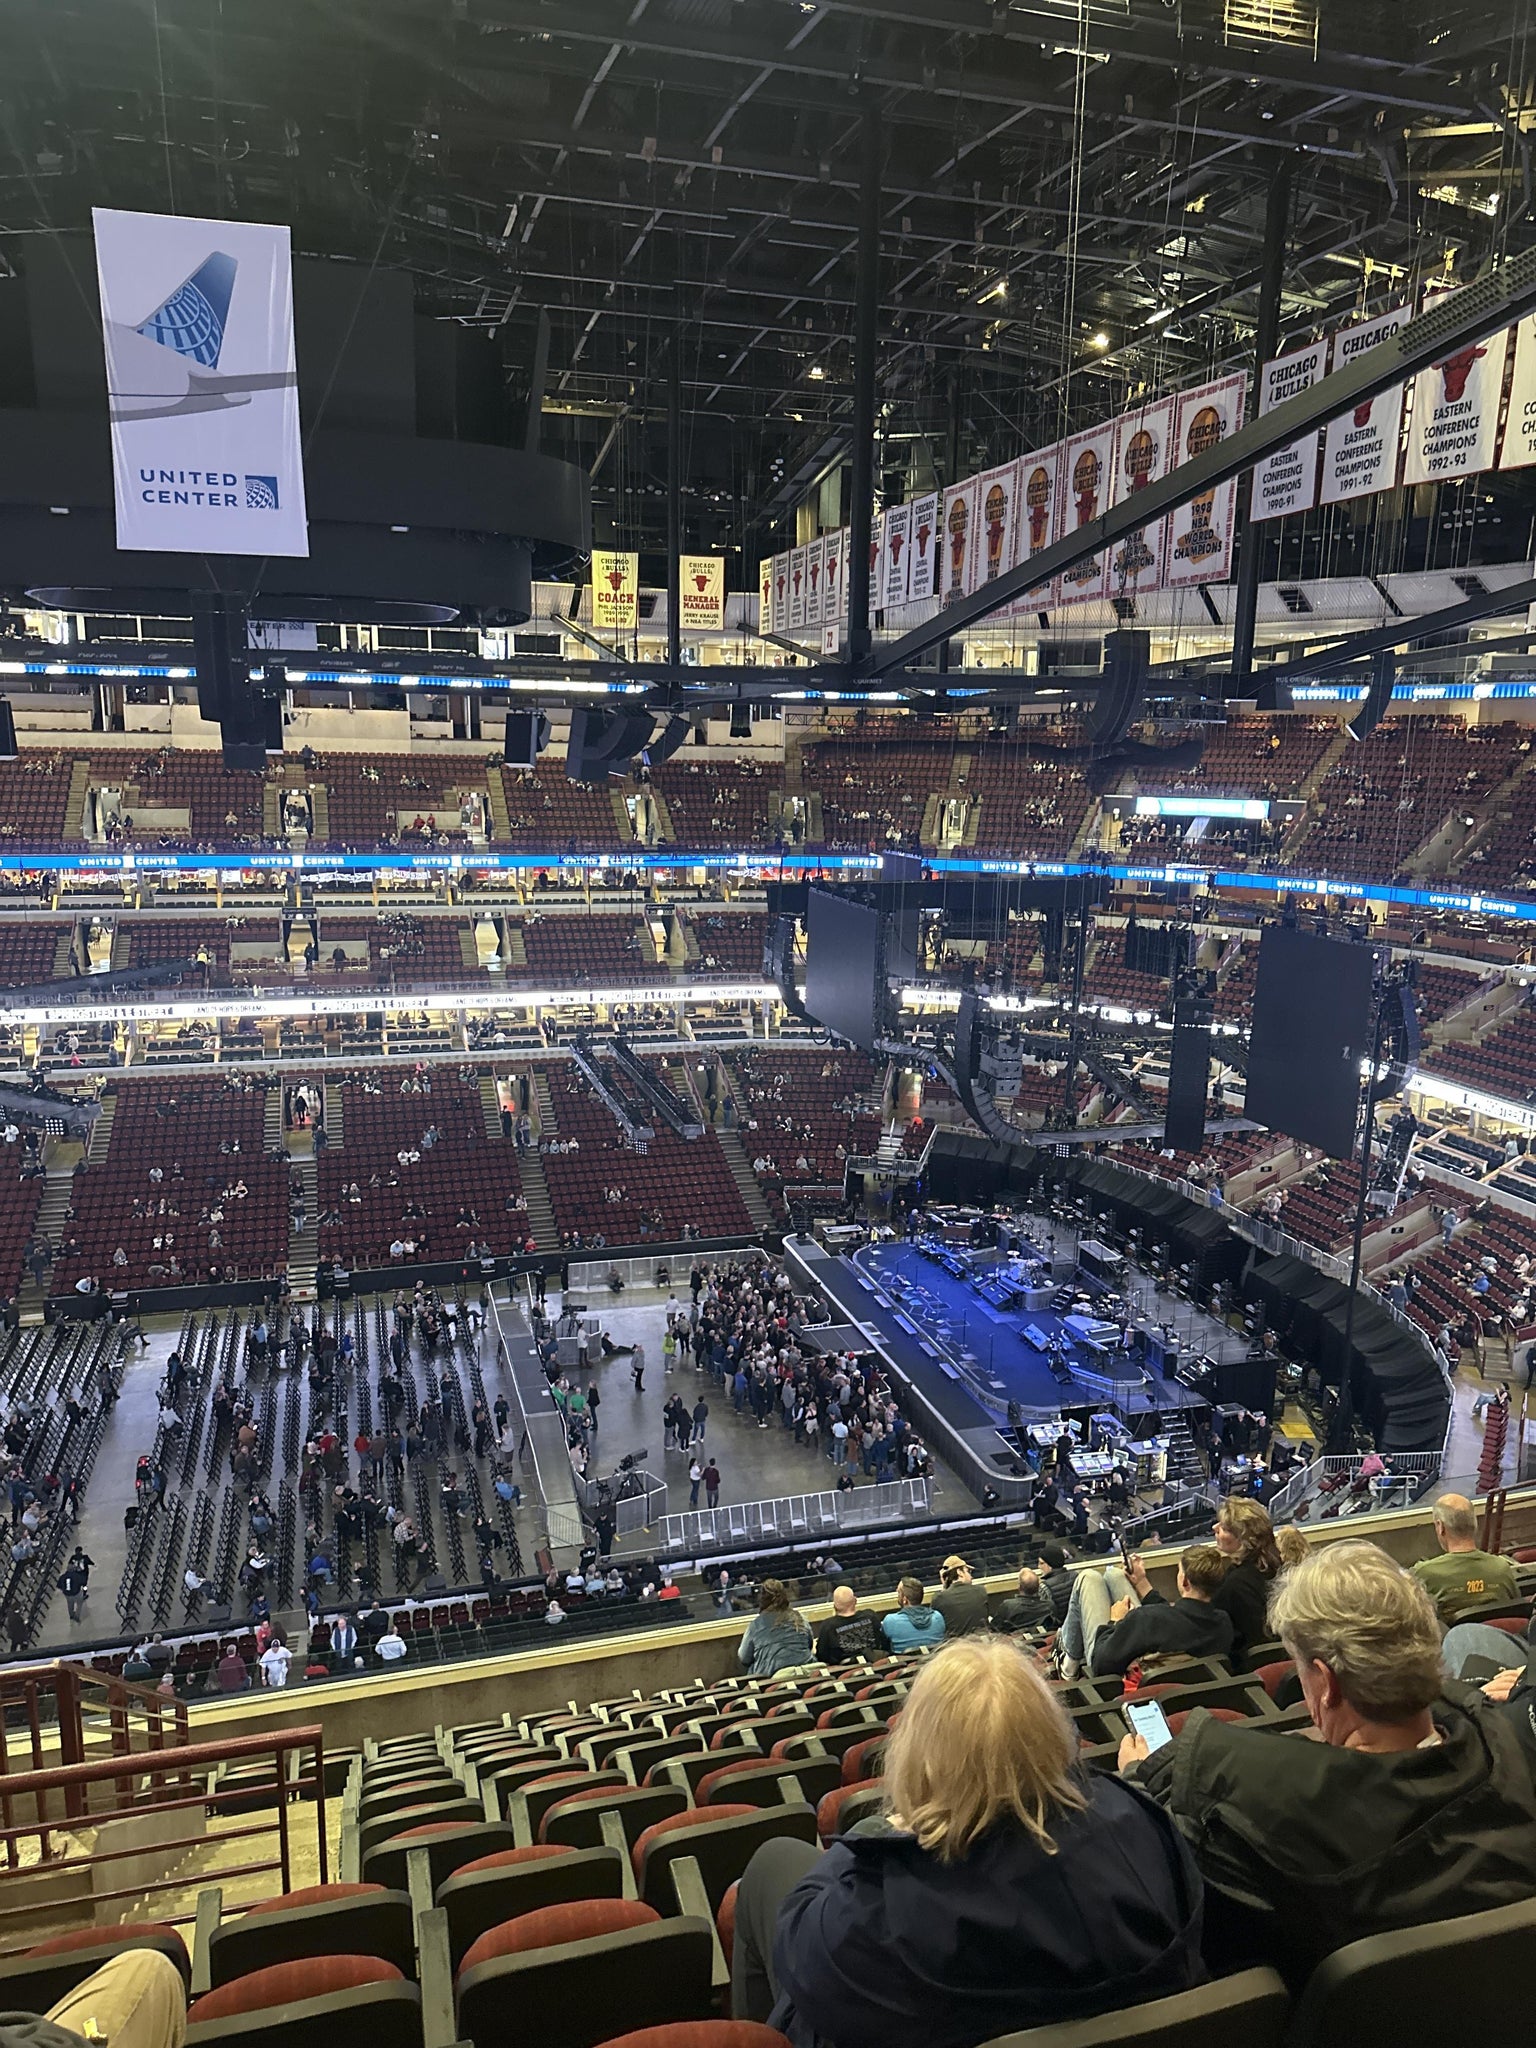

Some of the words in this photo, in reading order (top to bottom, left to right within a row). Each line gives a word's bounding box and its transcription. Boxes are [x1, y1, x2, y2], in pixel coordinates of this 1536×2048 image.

[1343, 321, 1399, 356] CHICAGO
[1269, 354, 1318, 386] CHICAGO
[1275, 377, 1309, 399] BULLS
[1434, 400, 1473, 421] EASTERN
[1189, 419, 1227, 440] CHICAGO
[1424, 415, 1480, 439] CONFERENCE
[1344, 426, 1377, 445] EASTERN
[1129, 443, 1158, 460] CHICAGO
[1335, 439, 1383, 463] CONFERENCE
[1422, 433, 1477, 456] CHAMPIONS
[1130, 458, 1153, 474] BULLS
[1270, 451, 1298, 469] EASTERN
[1335, 456, 1381, 478] CHAMPIONS
[1427, 452, 1467, 471] 1992-93
[140, 469, 237, 486] UNITED
[1074, 461, 1103, 479] CHICAGO
[1262, 463, 1303, 484] CONFERENCE
[1028, 480, 1053, 493] CHICAGO
[1077, 476, 1098, 491] BULLS
[1262, 480, 1302, 498] CHAMPIONS
[1340, 473, 1373, 492] 1991-92
[142, 490, 238, 507] CENTER
[986, 496, 1008, 511] CHICAGO
[1031, 493, 1049, 507] BULLS
[1267, 495, 1295, 510] 1990-91
[915, 500, 935, 514] CHICAGO
[989, 508, 1005, 521] BULLS
[1191, 501, 1212, 517] 1998
[889, 511, 908, 524] CHICAGO
[918, 512, 932, 526] BULLS
[950, 509, 969, 523] CHICAGO
[1192, 519, 1209, 529] NBA
[891, 522, 905, 534] BULLS
[1184, 529, 1214, 545] WORLD
[1174, 540, 1222, 560] CHAMPIONS
[1063, 567, 1102, 584] CHAMPIONS
[598, 592, 634, 604] COACH
[683, 595, 719, 603] GENERAL
[683, 602, 719, 610] MANAGER
[79, 858, 121, 866] UNITED
[135, 858, 178, 866] CENTER
[250, 857, 291, 865] UNITED
[304, 857, 345, 865] CENTER
[412, 857, 450, 865] UNITED
[462, 857, 500, 865] CENTER
[842, 858, 877, 866] UNITED
[982, 862, 1018, 872] UNITED
[1127, 869, 1164, 878] UNITED
[1277, 880, 1316, 890] UNITED
[1328, 884, 1364, 895] CENTER
[1429, 895, 1469, 907] UNITED
[1481, 901, 1517, 914] CENTER
[1466, 1580, 1484, 1593] 2023
